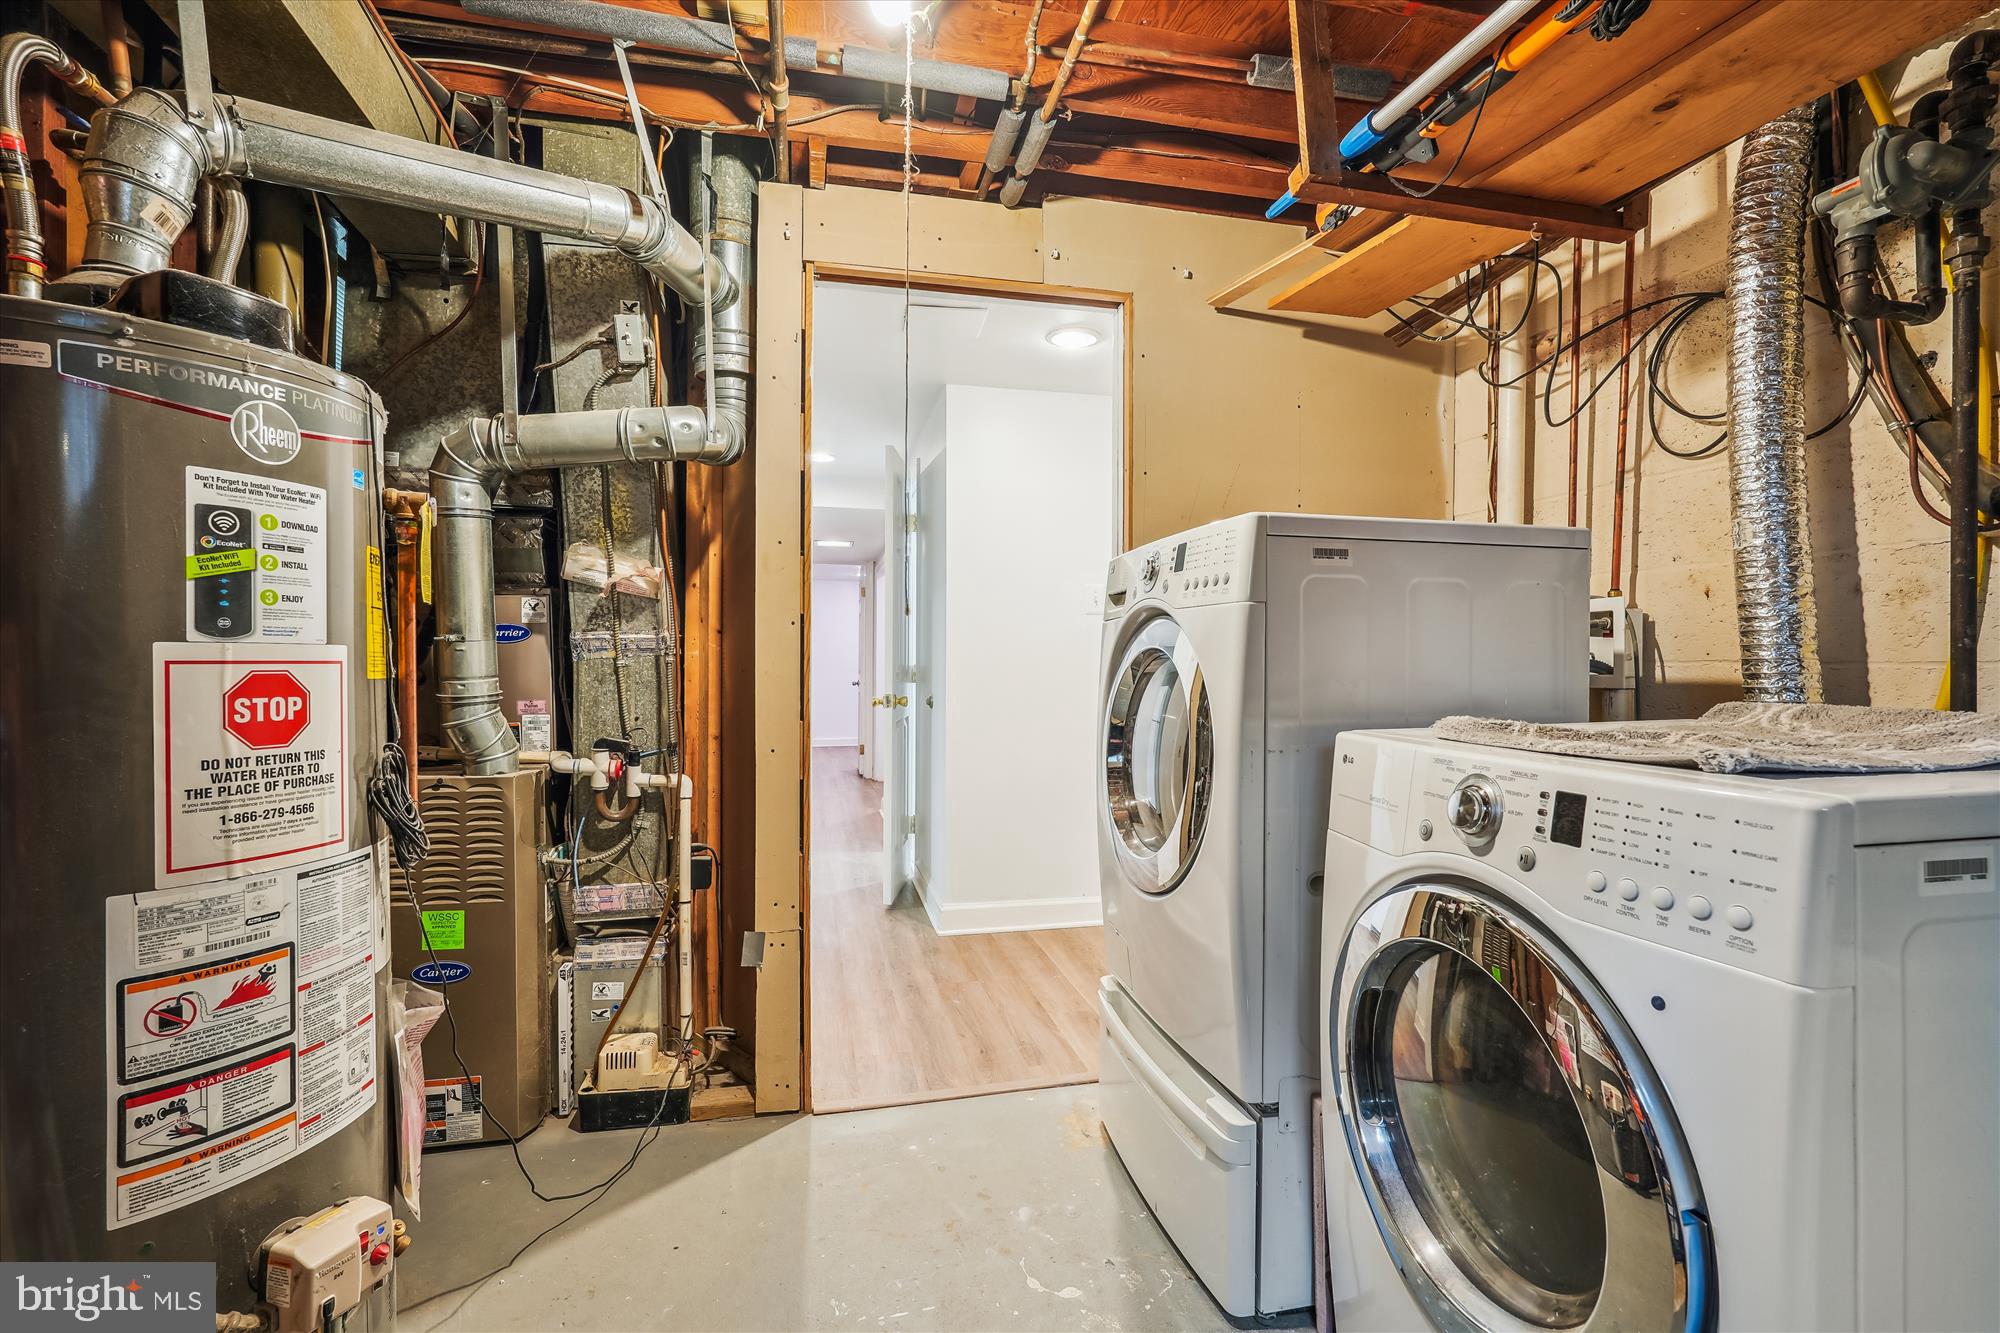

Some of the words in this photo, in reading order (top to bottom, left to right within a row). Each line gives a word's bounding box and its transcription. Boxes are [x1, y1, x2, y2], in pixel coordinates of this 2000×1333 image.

[96, 353, 286, 401] PERFORMANCE
[292, 392, 362, 426] PLATINUM
[242, 403, 296, 454] Rheem
[195, 474, 214, 482] Don't
[216, 476, 239, 486] Forget
[250, 481, 270, 490] Install
[272, 485, 285, 493] Your
[216, 484, 246, 494] Included
[248, 488, 263, 496] With
[265, 490, 279, 499] Your
[281, 493, 297, 502] Water
[299, 497, 316, 505] Heater
[281, 520, 318, 533] DOWNLOAD
[217, 540, 243, 548] EcoNet
[197, 554, 222, 564] EcoNet
[199, 563, 210, 571] Kit
[212, 560, 241, 569] Included
[282, 561, 308, 570] INSTALL
[282, 595, 303, 603] ENJOY
[233, 697, 302, 723] STOP
[201, 759, 220, 771] DO
[225, 756, 252, 769] NOT
[256, 753, 301, 767] RETURN
[304, 750, 326, 761] THIS
[210, 770, 257, 784] WATER
[261, 764, 304, 780] HEATER
[308, 763, 320, 773] TO
[184, 788, 213, 800] THE
[218, 784, 260, 797] PLACE
[265, 781, 280, 792] OF
[284, 773, 334, 789] PURCHASE
[219, 802, 315, 826] 1-866-279-4566
[1594, 898, 1608, 907] LEVEL
[428, 912, 459, 921] WSSC
[1616, 909, 1640, 920] CONTROL
[1656, 914, 1669, 922] TIME
[1688, 926, 1711, 936] BEEPER
[1729, 934, 1754, 946] OPTION
[193, 960, 251, 980] WARNING
[420, 968, 463, 978] Carrier
[213, 1008, 244, 1019] Flammable
[203, 1023, 233, 1034] EXPLOSION
[233, 1016, 254, 1025] HAZARD
[200, 1066, 247, 1088] DANGER
[176, 1115, 191, 1123] HOT
[198, 1134, 250, 1159] WARNING
